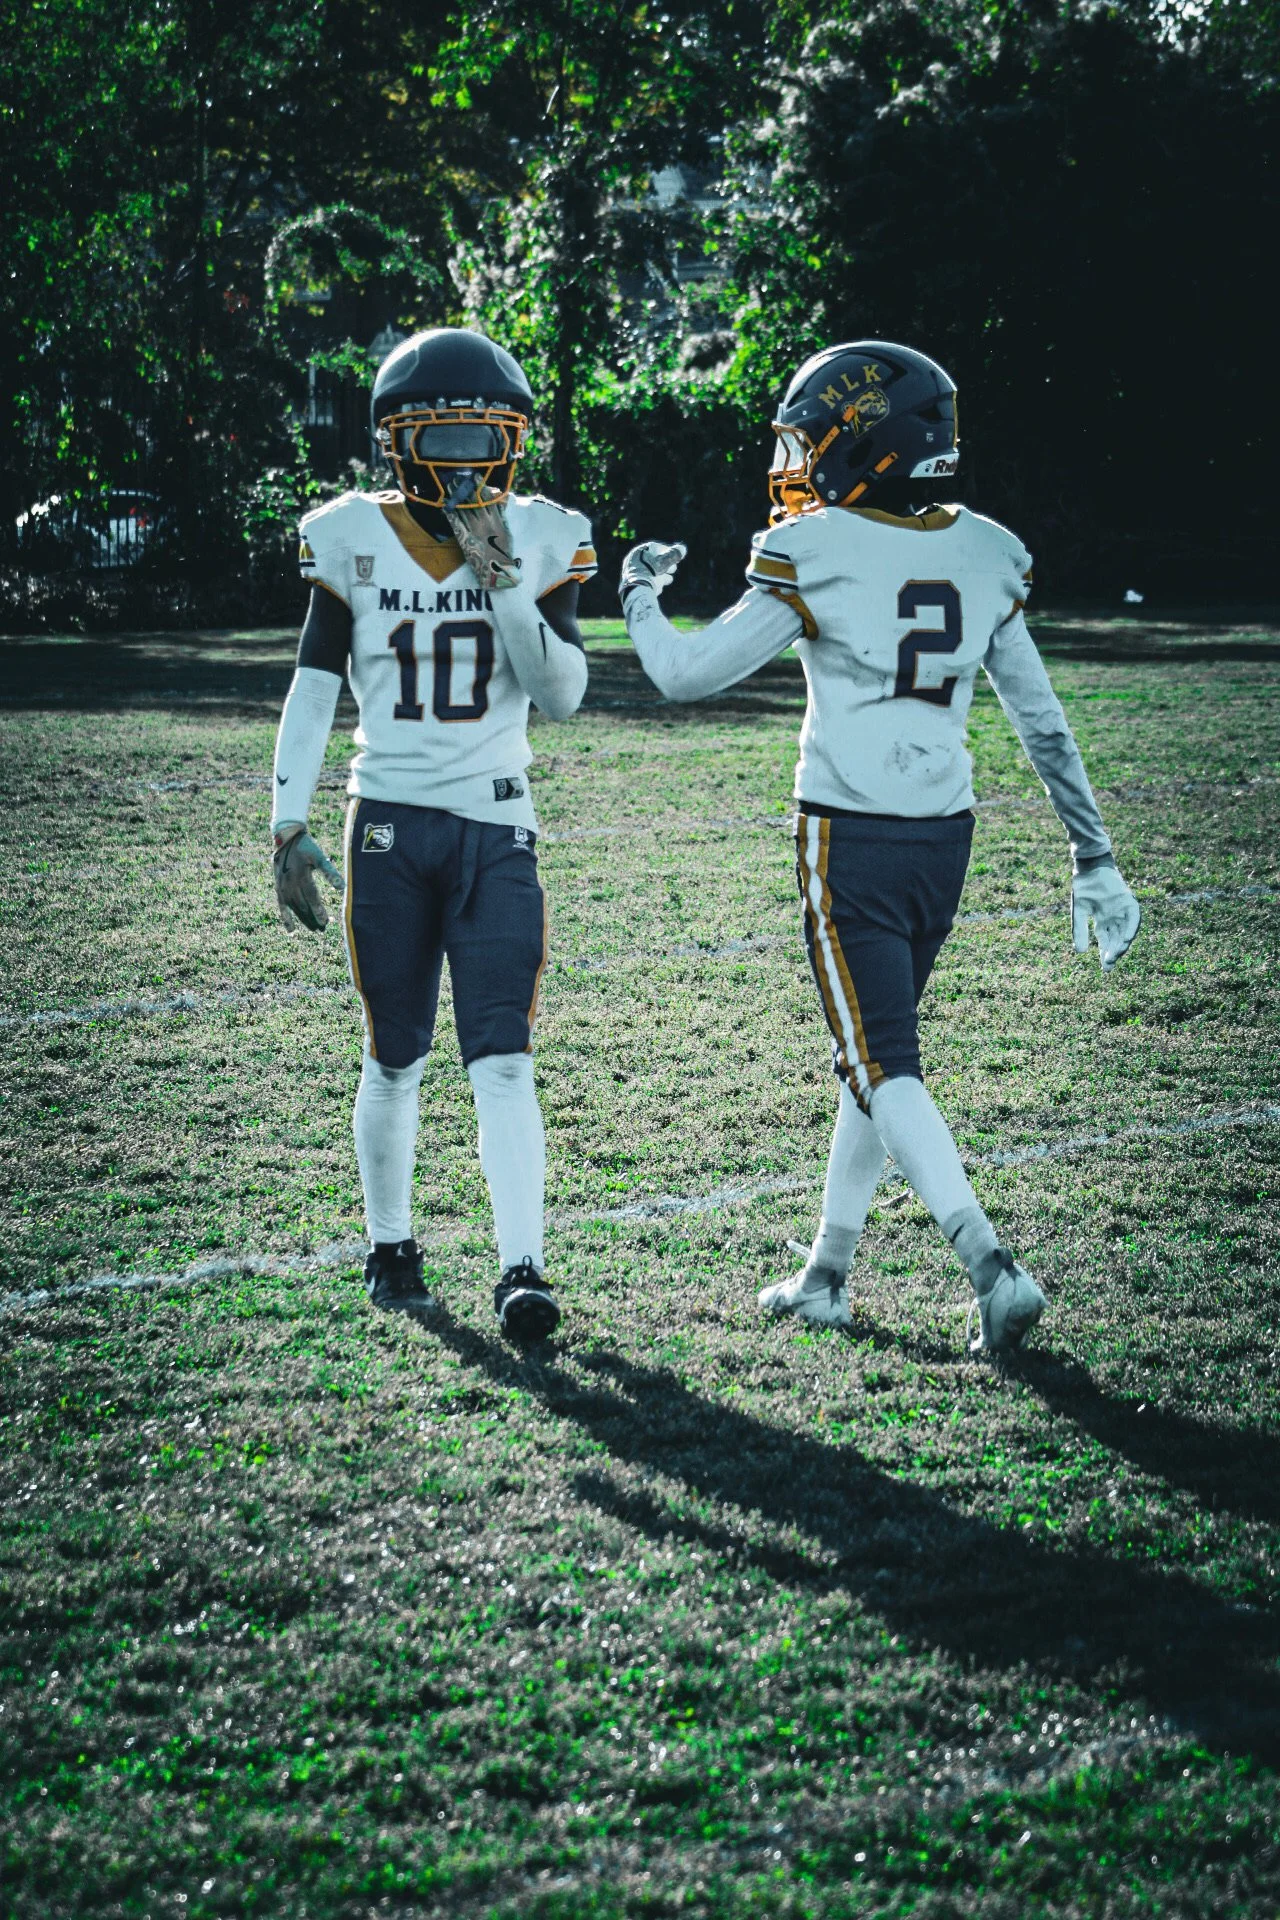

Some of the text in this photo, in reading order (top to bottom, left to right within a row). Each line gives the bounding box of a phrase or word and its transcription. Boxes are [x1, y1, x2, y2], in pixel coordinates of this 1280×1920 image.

[818, 364, 882, 410] MLK
[388, 619, 495, 724] 10
[894, 580, 963, 707] 2
